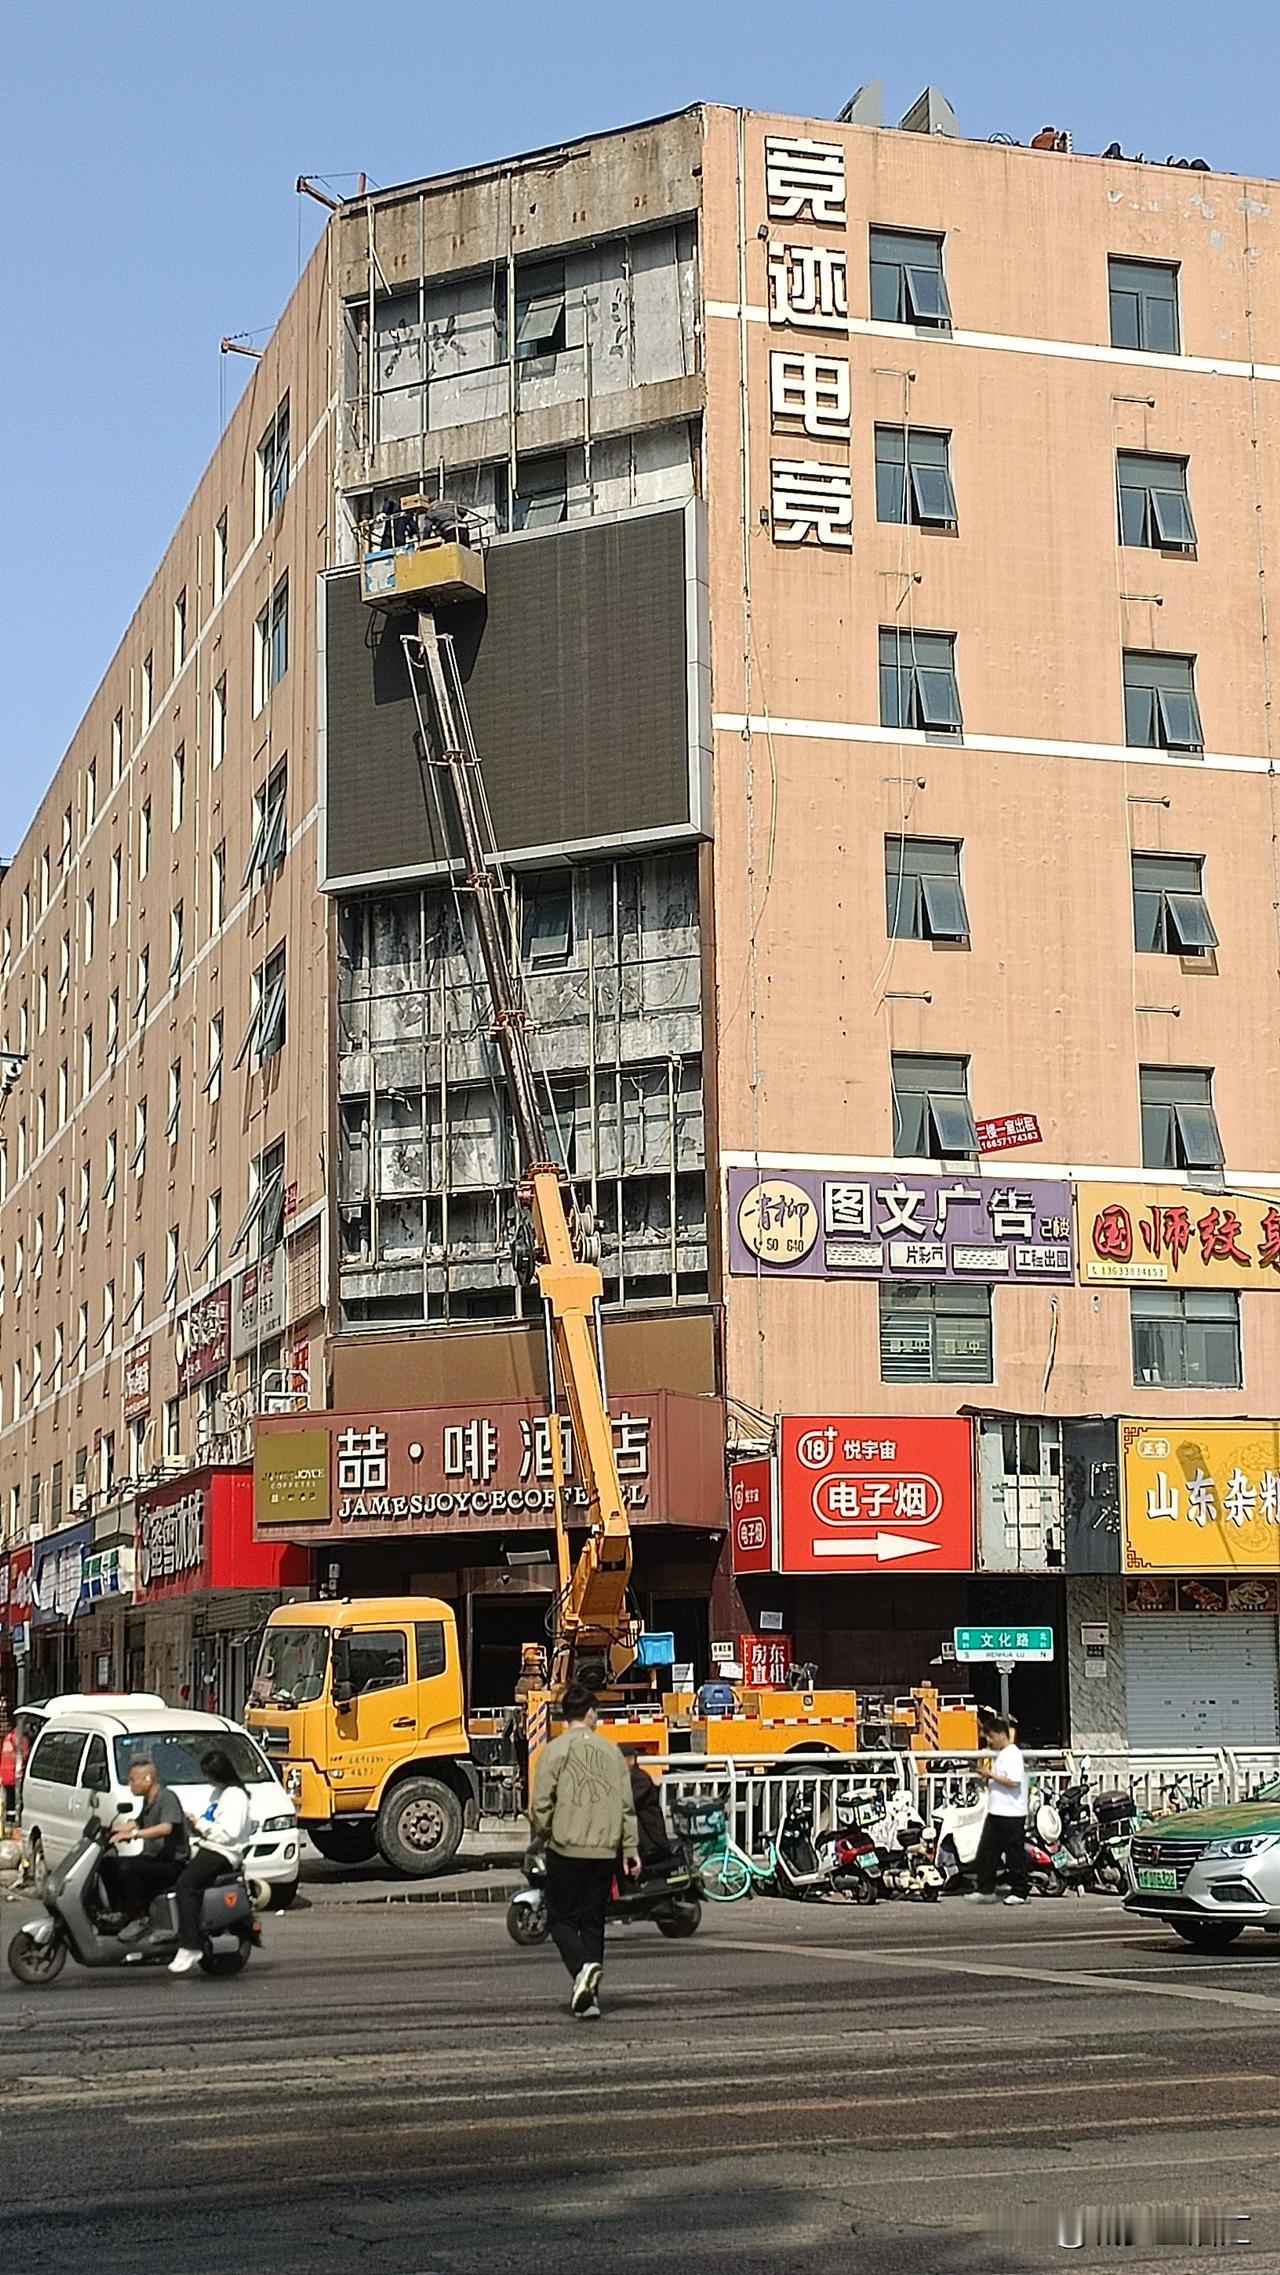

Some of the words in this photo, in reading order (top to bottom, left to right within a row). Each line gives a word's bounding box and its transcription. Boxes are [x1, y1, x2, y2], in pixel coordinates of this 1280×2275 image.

[765, 136, 852, 548] 竞迹电竞
[823, 1182, 1036, 1239] 图文广告
[1018, 1249, 1069, 1268] 工程出图
[843, 1439, 897, 1460] 悦宇宙
[338, 1484, 646, 1518] JAMESJOYCECOFFEL
[828, 1480, 927, 1519] 电子烟
[980, 1632, 1029, 1648] 文化路
[752, 1643, 785, 1664] 房东
[751, 1664, 786, 1685] 直租
